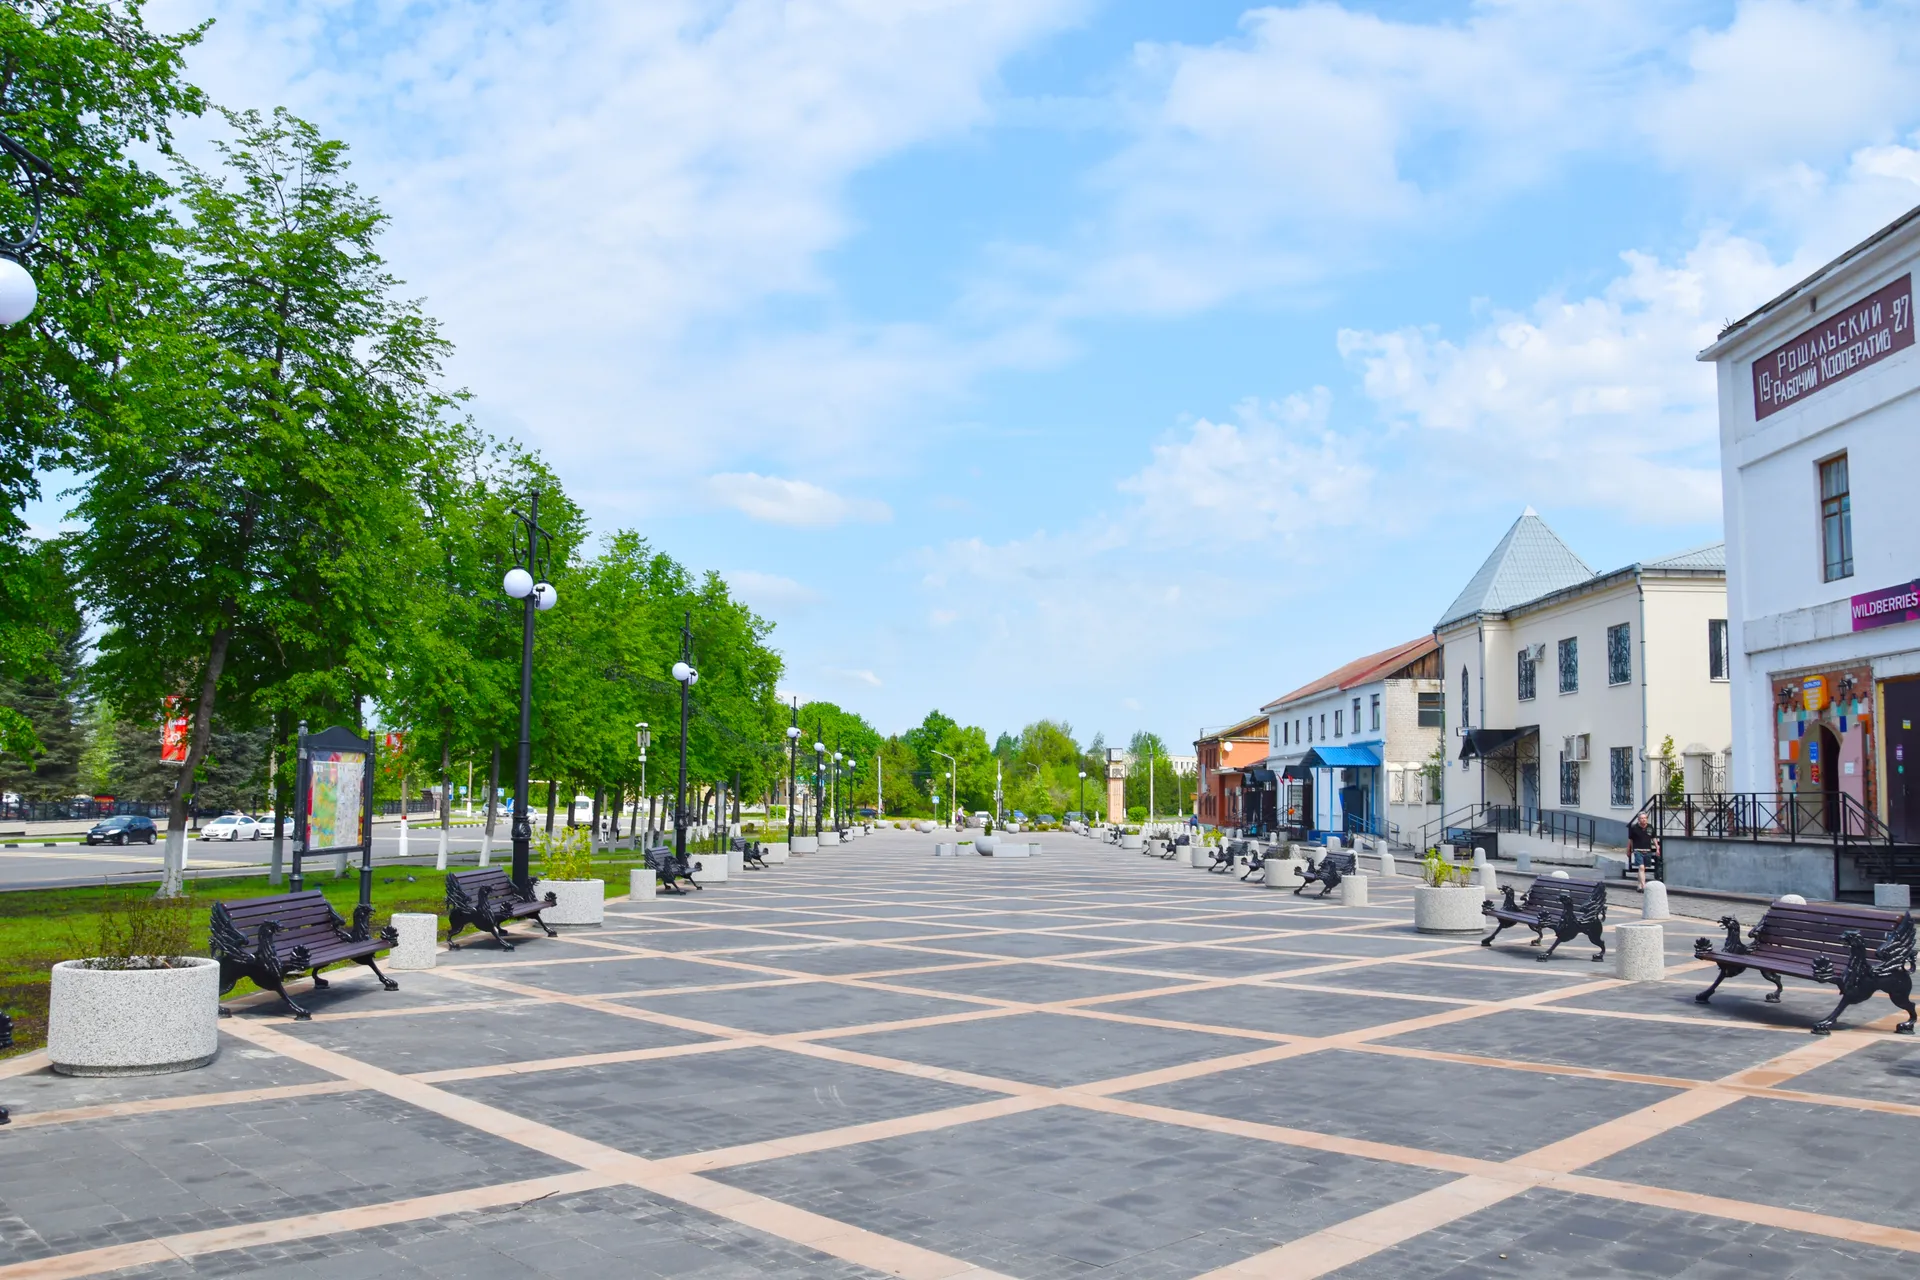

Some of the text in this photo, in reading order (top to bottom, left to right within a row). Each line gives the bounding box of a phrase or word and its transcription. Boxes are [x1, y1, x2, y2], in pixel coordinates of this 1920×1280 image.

[1773, 328, 1892, 405] РАБОЧИЙ КООПЕРАТИВ
[1777, 300, 1882, 378] РОШАЛЬСКИЙ
[1852, 592, 1919, 619] WILDBERRIES
